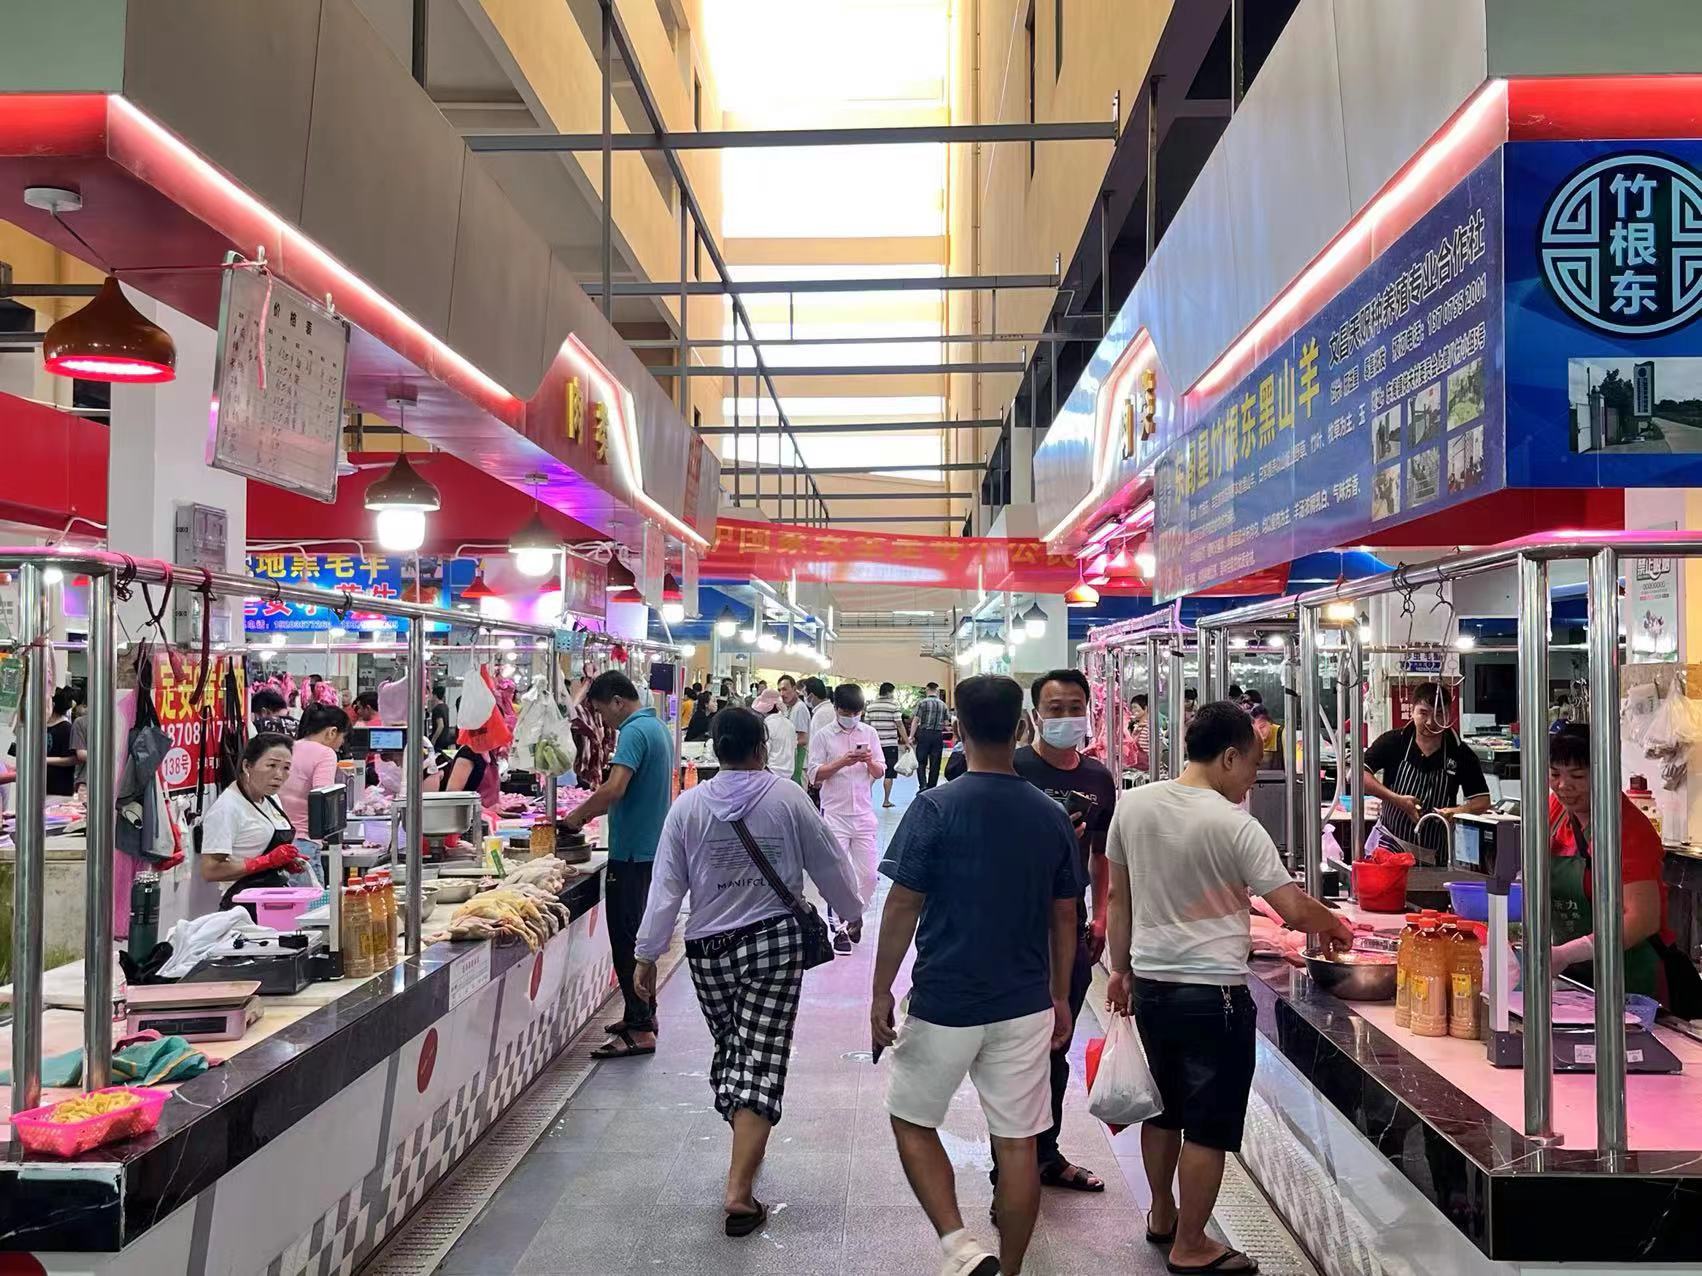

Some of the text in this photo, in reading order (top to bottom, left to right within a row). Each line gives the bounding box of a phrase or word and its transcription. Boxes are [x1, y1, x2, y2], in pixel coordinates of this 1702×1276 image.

[1609, 173, 1658, 316] 竹根东
[164, 754, 189, 776] 138号
[718, 878, 772, 890] MANIFOL
